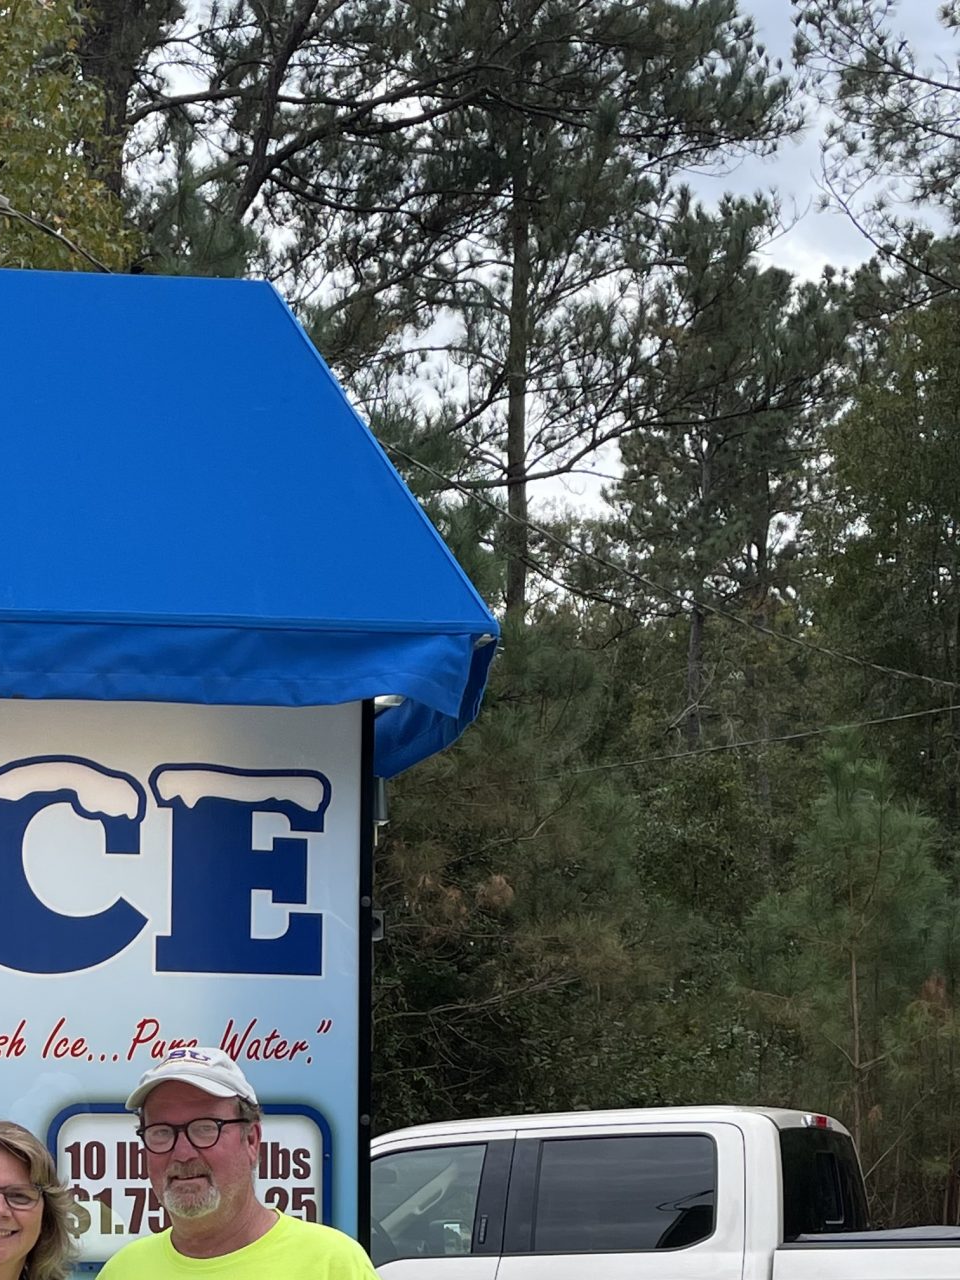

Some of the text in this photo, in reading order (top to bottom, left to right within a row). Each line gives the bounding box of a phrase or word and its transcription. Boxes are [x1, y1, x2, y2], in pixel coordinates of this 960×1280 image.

[64, 1141, 106, 1180] 10
[258, 1141, 312, 1180] lbs
[65, 1183, 173, 1239] $1.75
